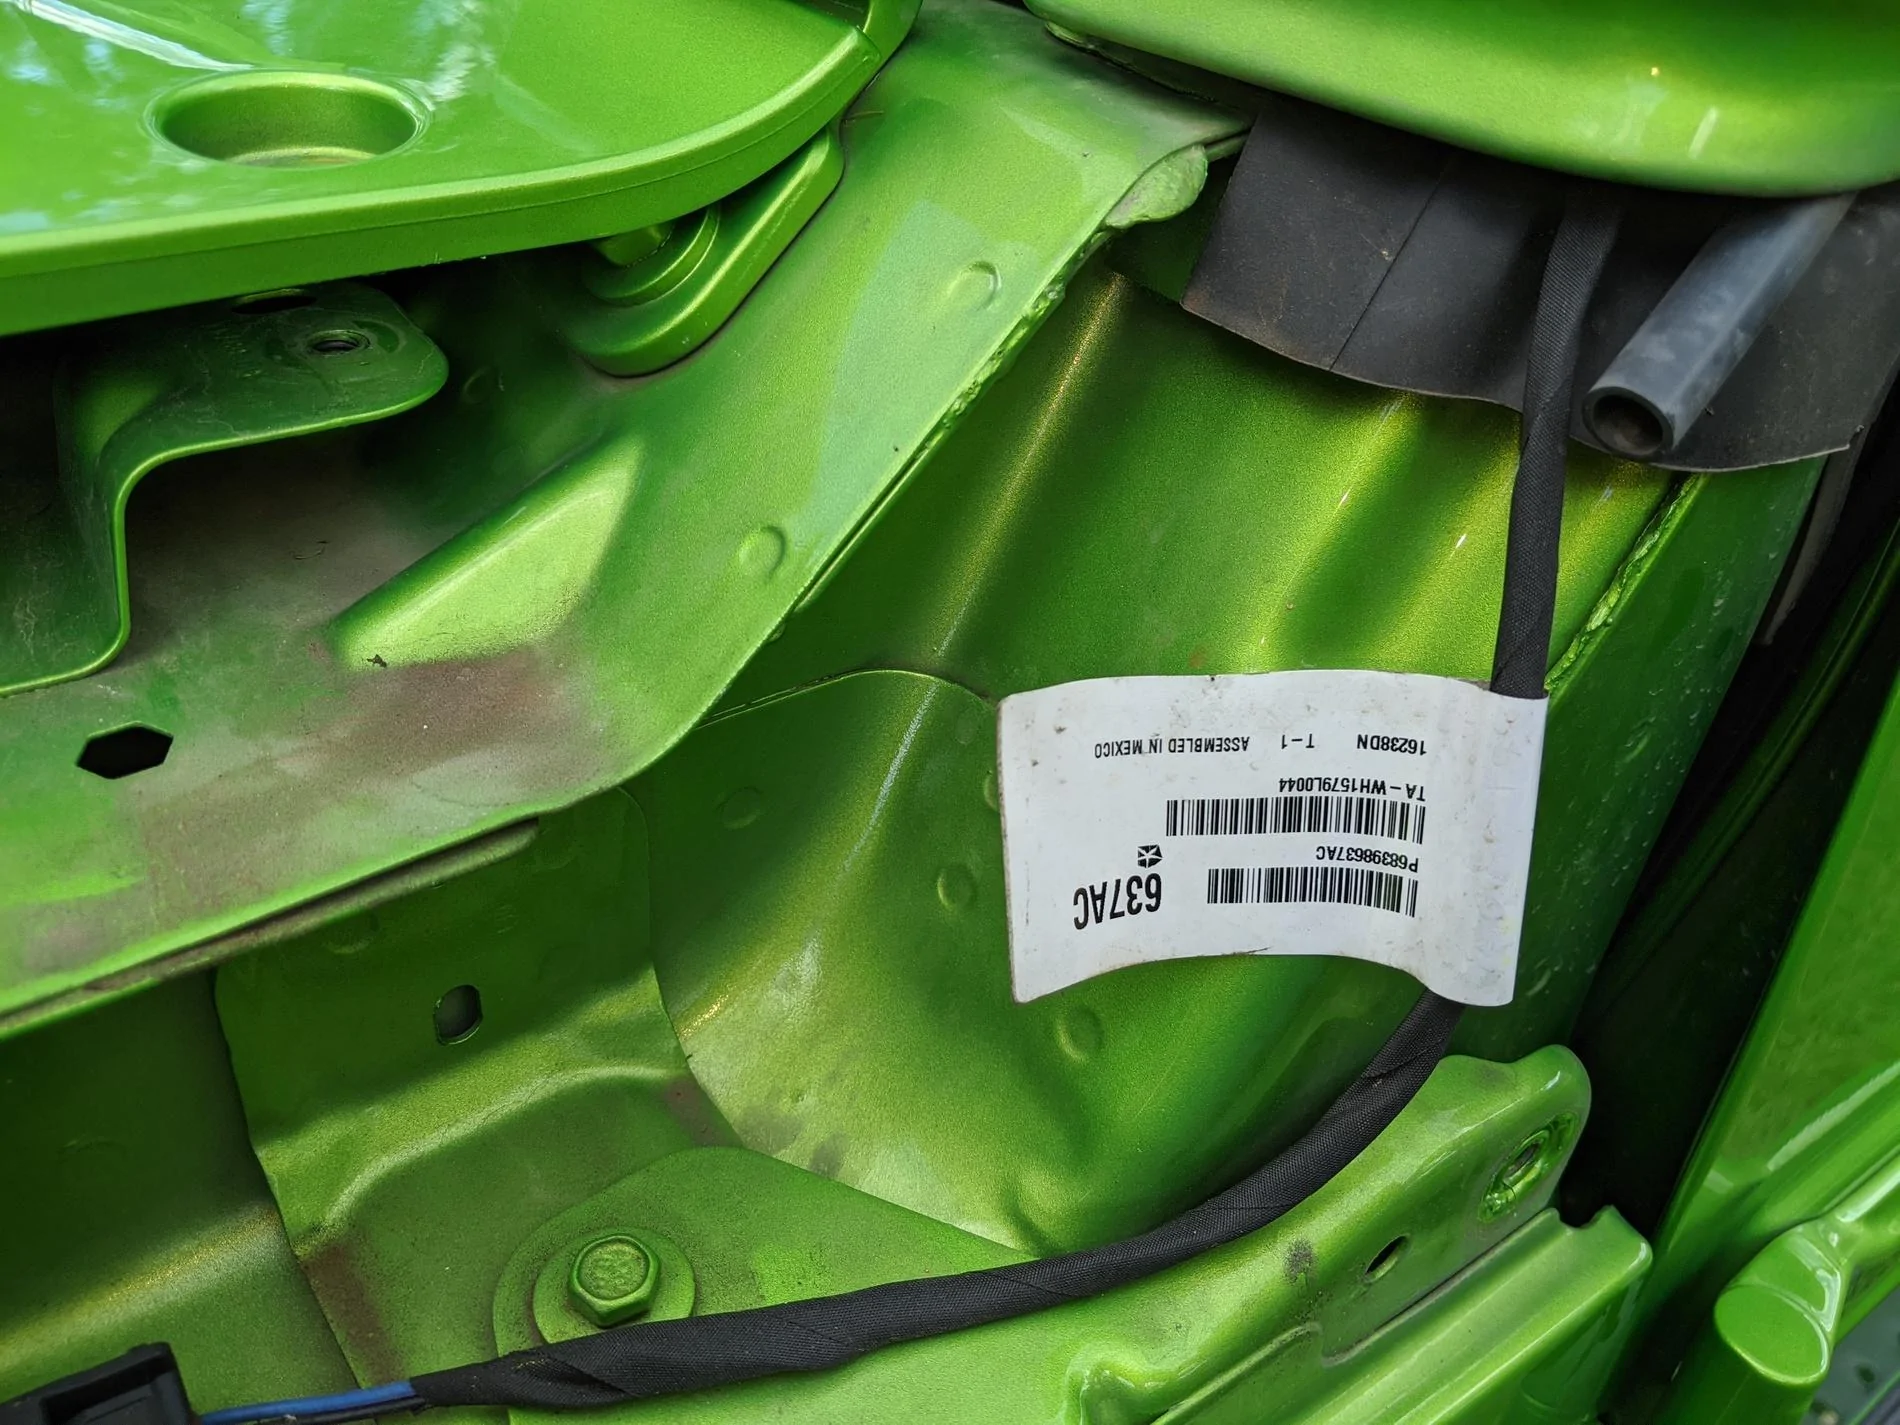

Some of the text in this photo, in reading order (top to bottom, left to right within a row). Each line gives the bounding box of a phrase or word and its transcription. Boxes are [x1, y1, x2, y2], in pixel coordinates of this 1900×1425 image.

[1094, 739, 1142, 759] MEXICO
[1148, 738, 1163, 754] IN
[1168, 736, 1250, 753] ASSEMBLED
[1356, 734, 1427, 756] 16238DN
[1315, 845, 1419, 873] P68398637AC
[1073, 873, 1162, 930] 637AC
